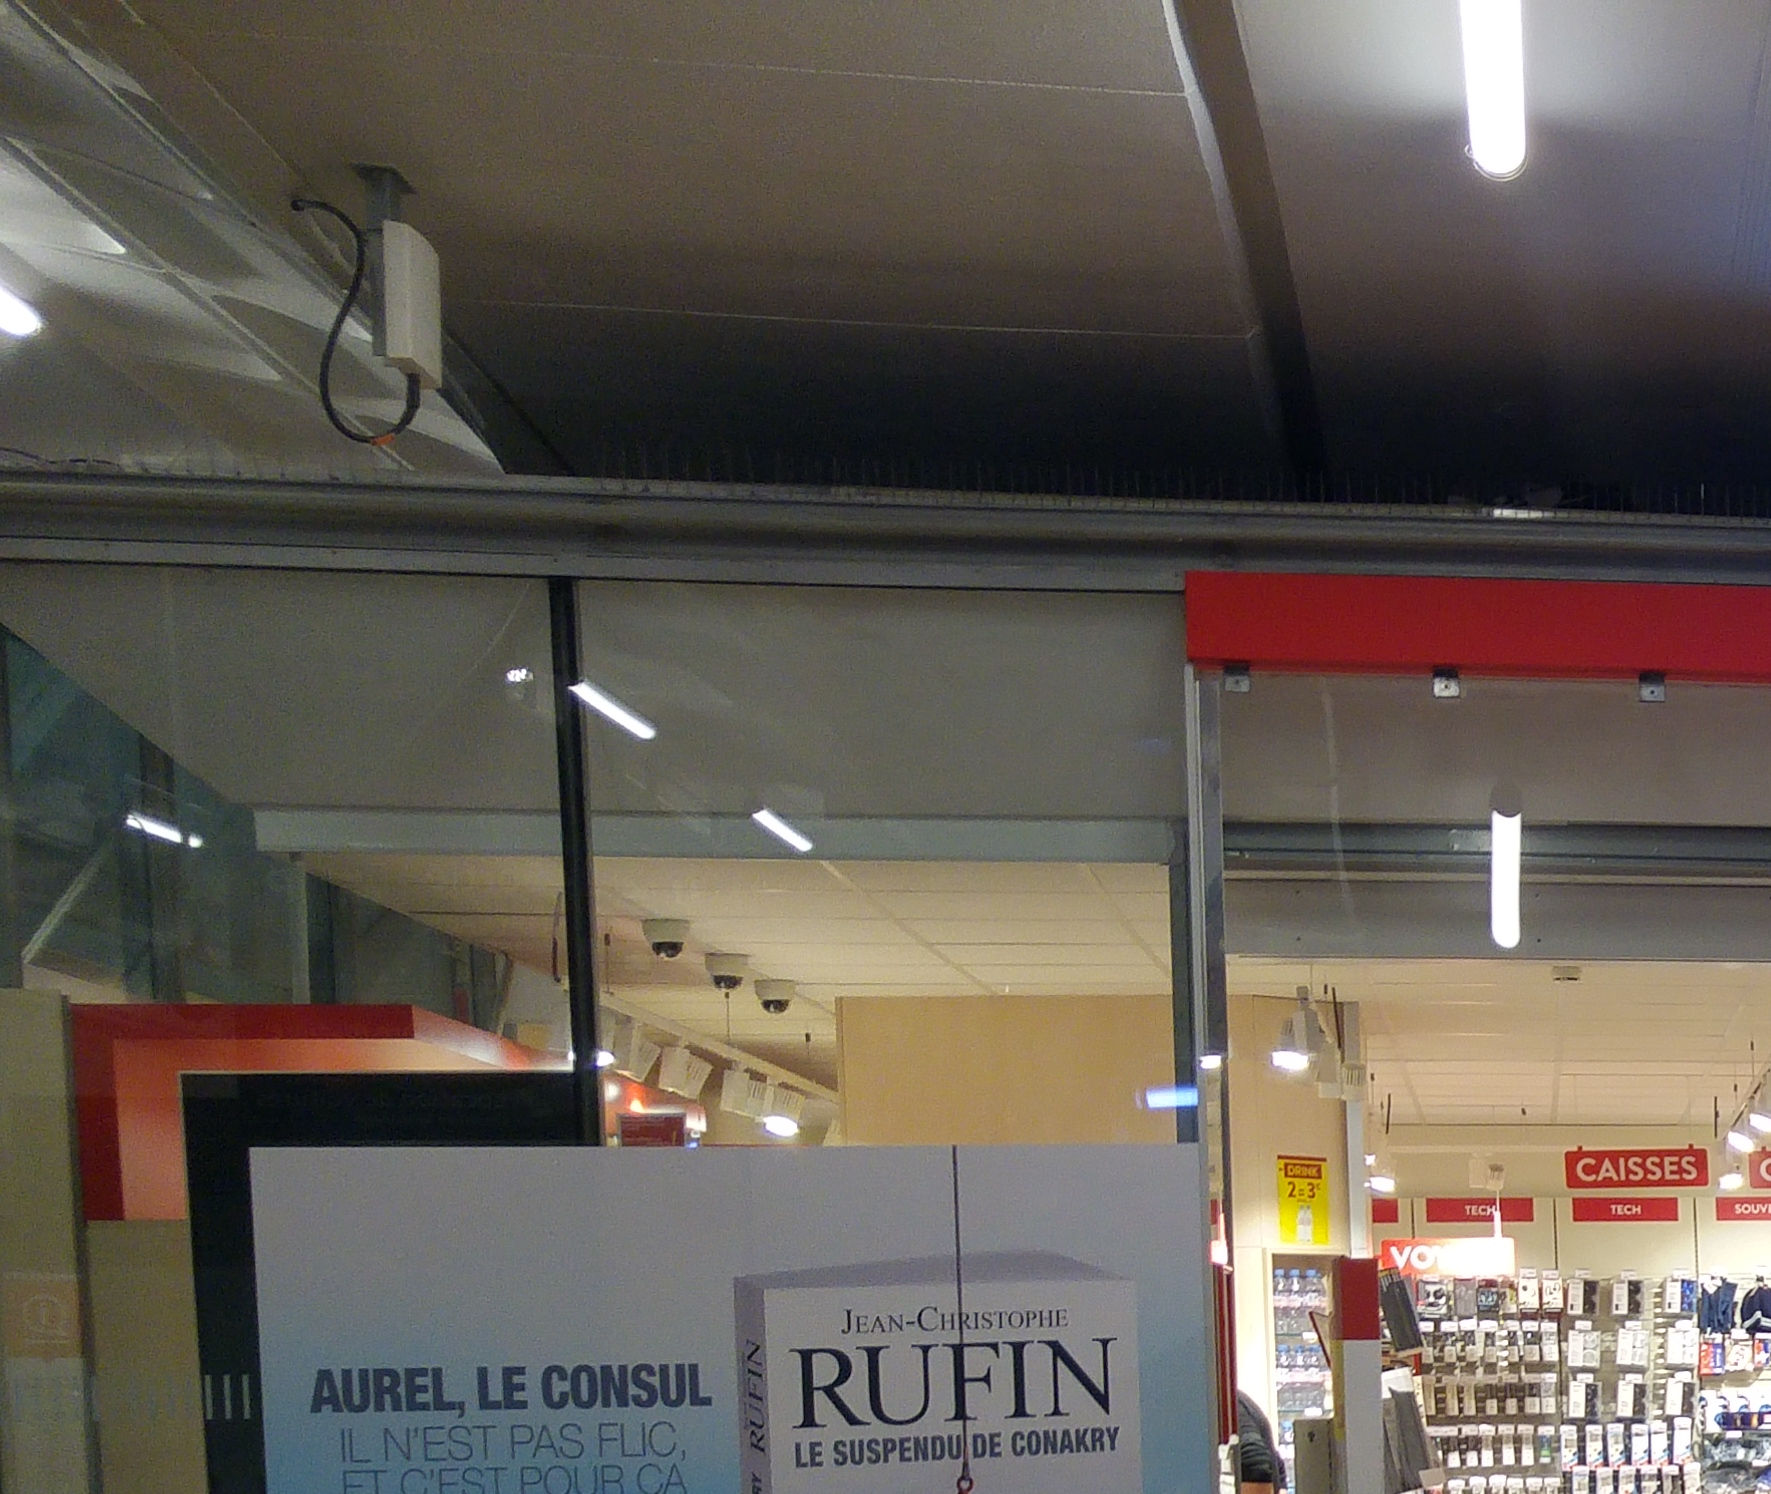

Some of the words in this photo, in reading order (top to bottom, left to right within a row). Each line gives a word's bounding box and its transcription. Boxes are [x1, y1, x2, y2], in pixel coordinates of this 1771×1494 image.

[1287, 1165, 1320, 1177] DRINK
[1575, 1155, 1698, 1182] CAISSES
[1465, 1205, 1498, 1216] TECH
[1610, 1204, 1641, 1215] TECH
[310, 1366, 467, 1420] AUREL,
[476, 1366, 529, 1411] LE
[540, 1362, 713, 1411] CONSUL
[746, 1338, 766, 1454] RUFIN
[789, 1337, 1118, 1429] RUFIN
[340, 1429, 372, 1464] IL
[384, 1425, 498, 1462] N'EST
[510, 1423, 585, 1460] PAS
[597, 1420, 687, 1462] FLIC,
[795, 1441, 823, 1468] LE
[833, 1434, 964, 1467] SUSPENDU
[972, 1432, 1002, 1459] DE
[1011, 1426, 1121, 1458] CONAKRY
